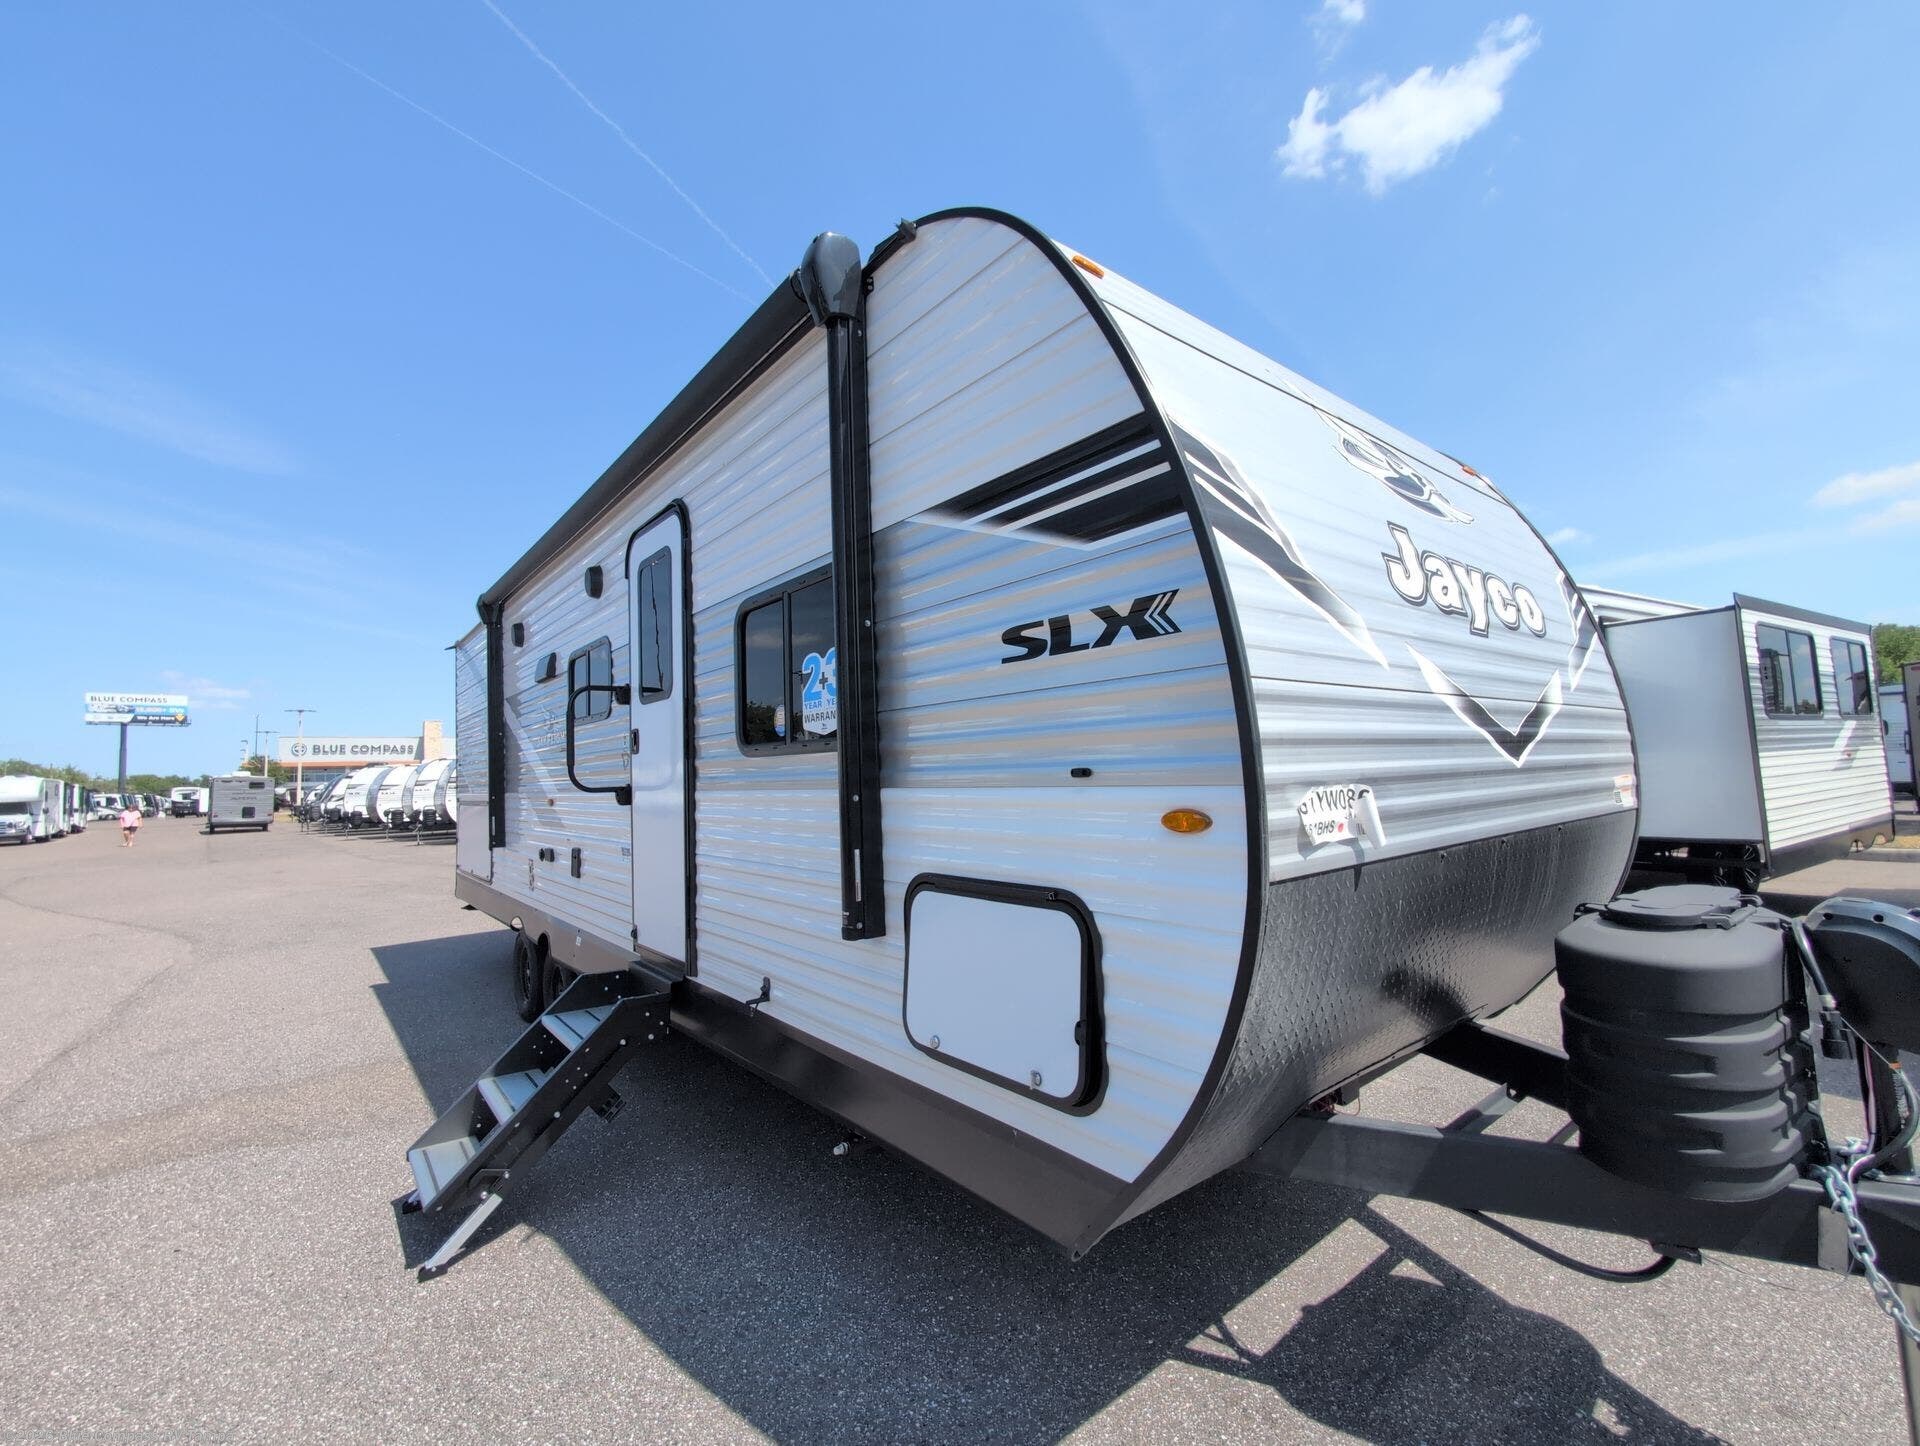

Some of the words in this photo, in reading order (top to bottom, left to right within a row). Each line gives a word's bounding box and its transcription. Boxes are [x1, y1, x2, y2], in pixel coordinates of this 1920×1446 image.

[1381, 520, 1547, 638] Jayco
[1001, 588, 1182, 664] SLX
[804, 701, 823, 710] YEAR
[827, 698, 837, 707] YE
[804, 710, 837, 724] WARRAN
[312, 744, 346, 756] BLUE
[350, 744, 414, 756] COMPASS
